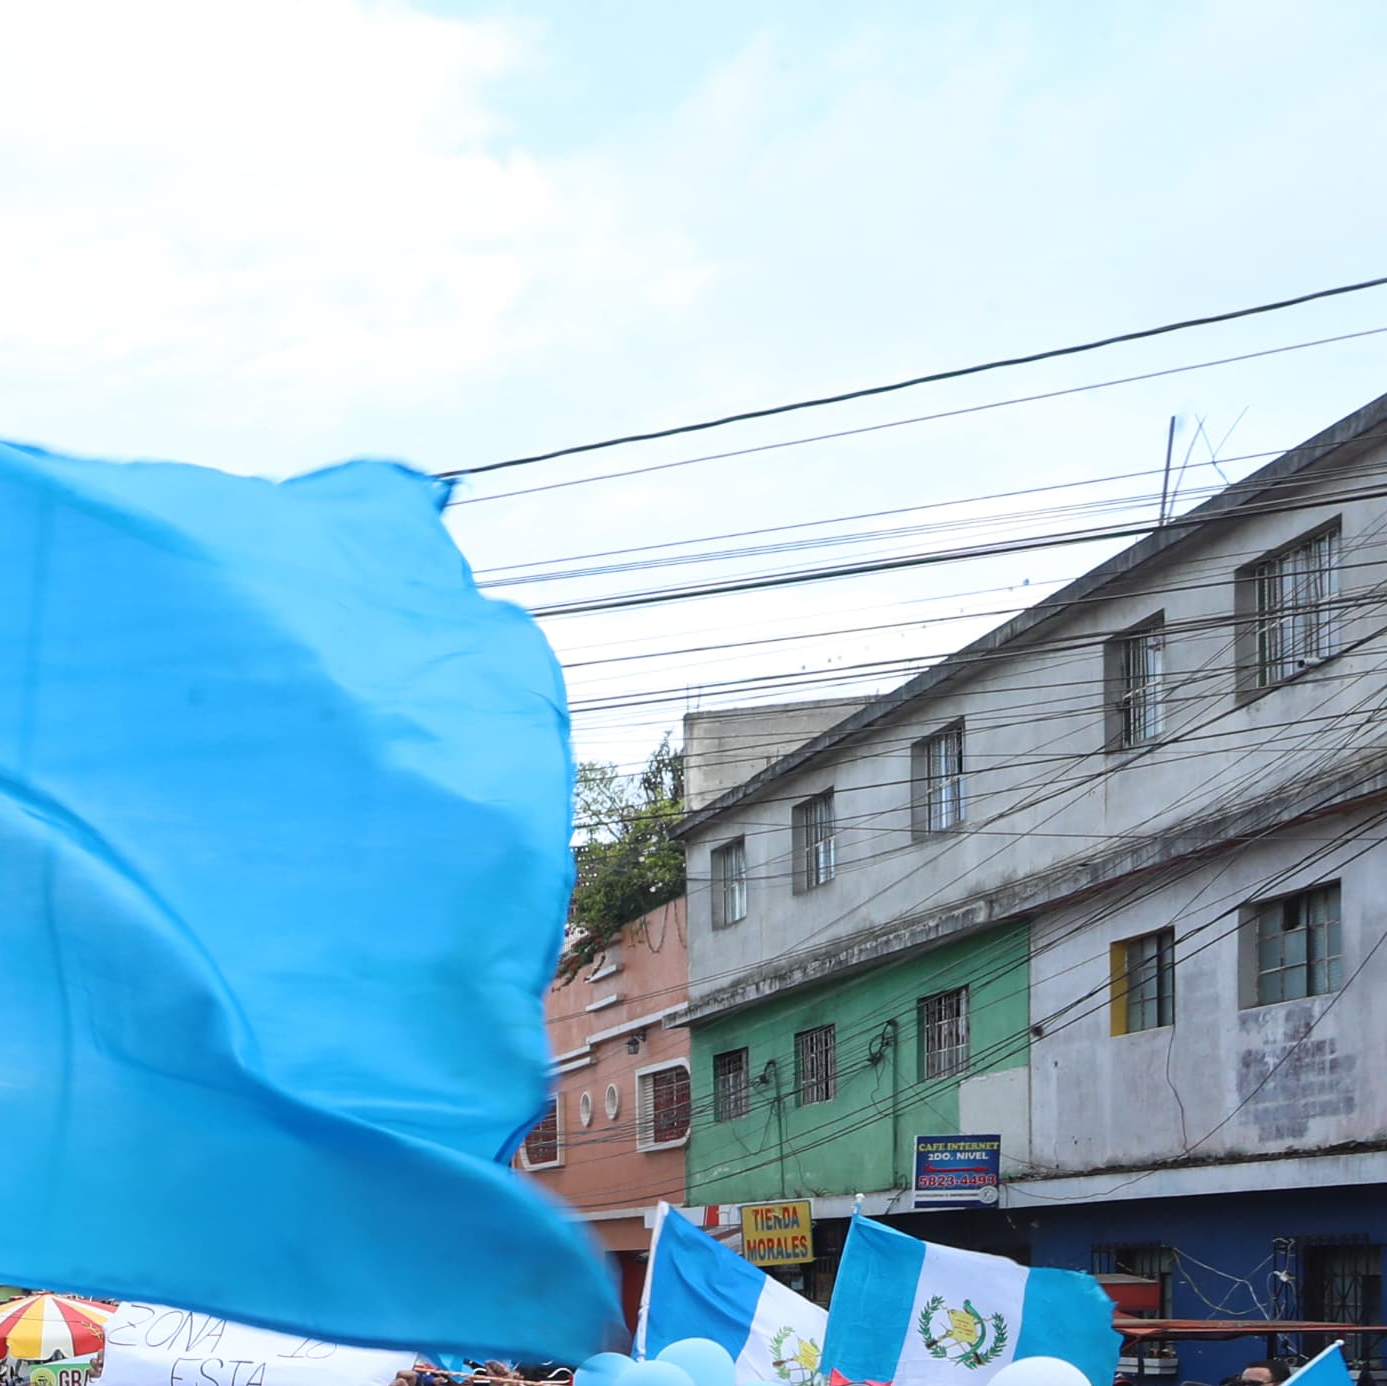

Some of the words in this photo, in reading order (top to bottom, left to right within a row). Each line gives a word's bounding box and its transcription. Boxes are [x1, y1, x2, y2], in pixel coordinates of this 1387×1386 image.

[918, 1142, 946, 1152] CAFE
[947, 1141, 999, 1151] INTERNET
[956, 1151, 989, 1160] NIVEL
[917, 1174, 997, 1188] 5823-4493
[752, 1206, 800, 1232] TIENDA
[746, 1235, 809, 1262] MORALES
[107, 1304, 227, 1352] ZONA
